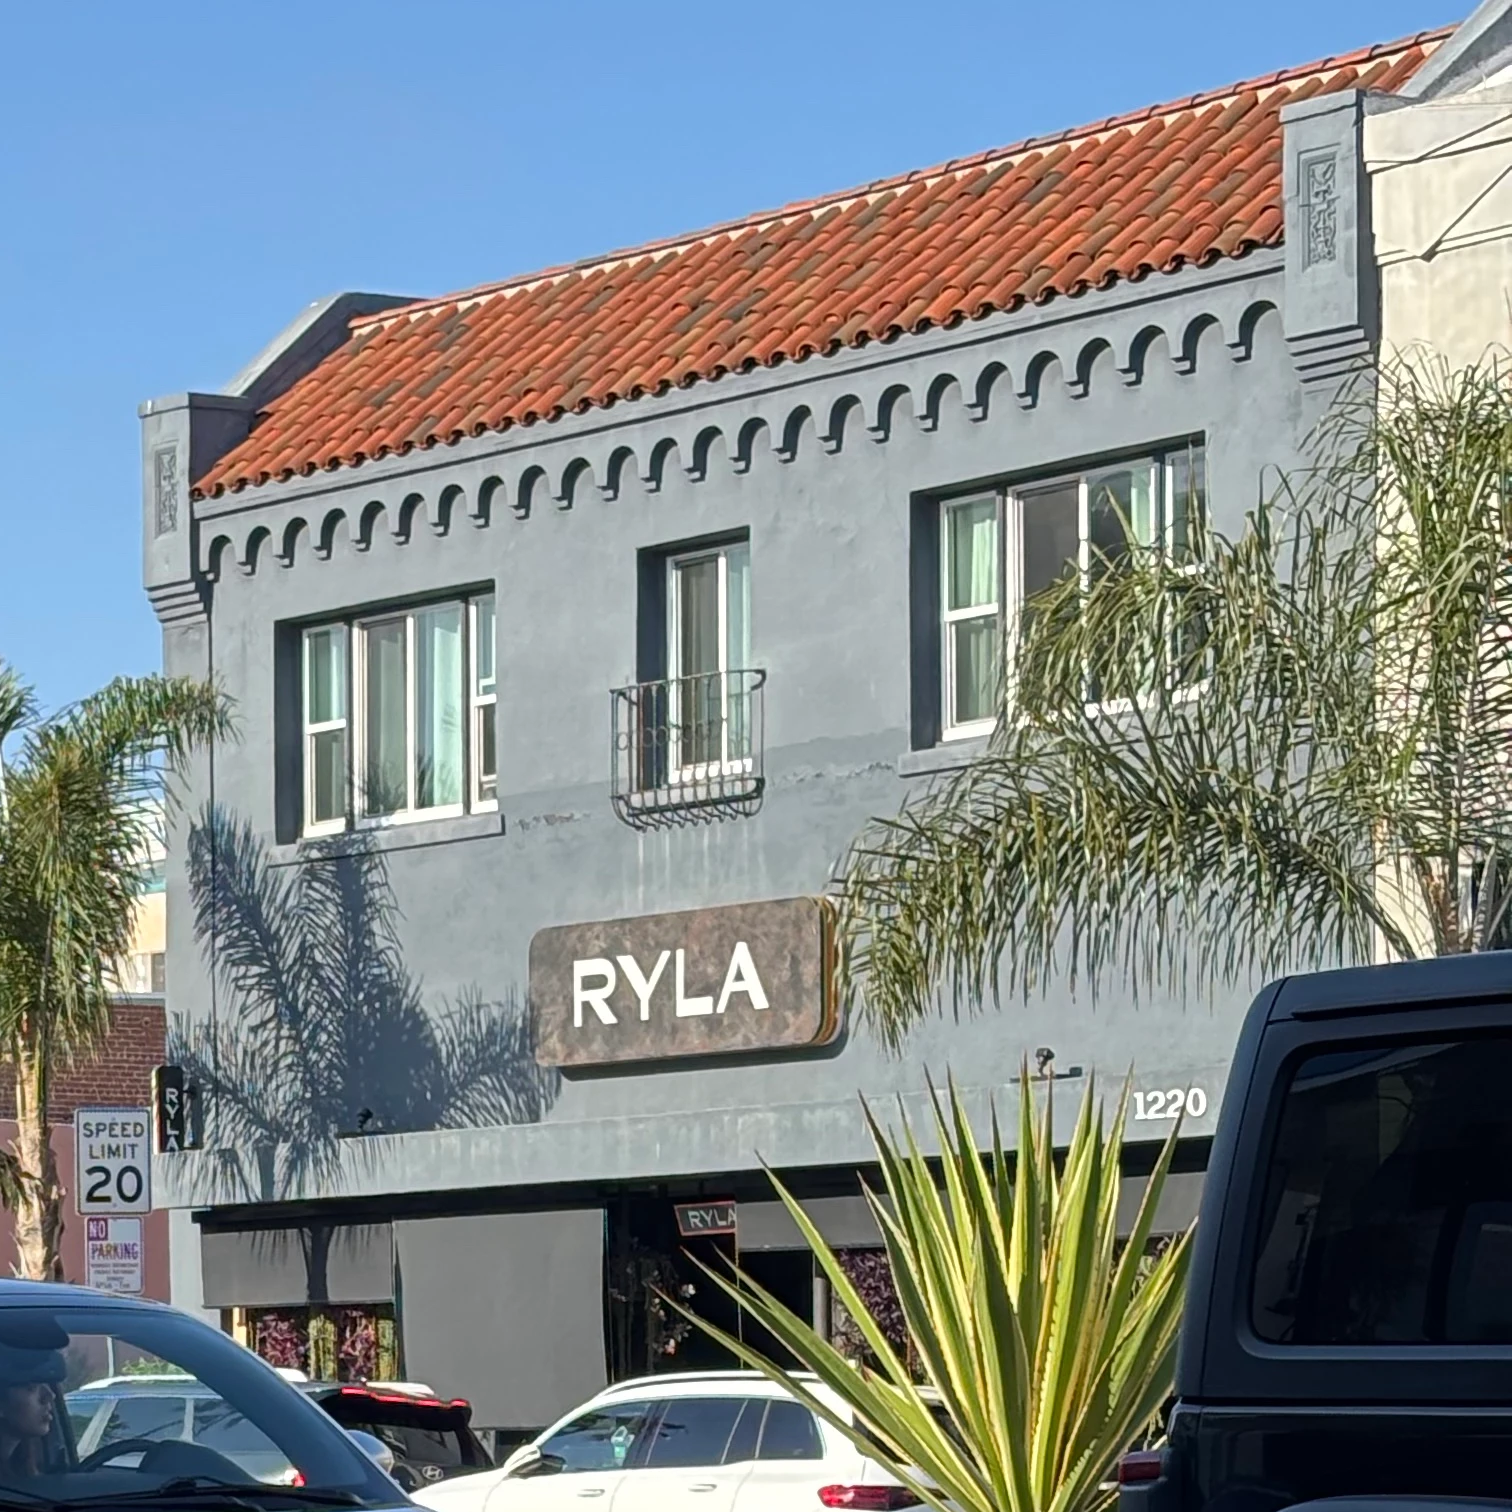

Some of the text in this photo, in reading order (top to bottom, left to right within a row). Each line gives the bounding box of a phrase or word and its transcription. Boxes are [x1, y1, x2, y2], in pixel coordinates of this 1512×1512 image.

[573, 941, 769, 1027] RYLA
[1133, 1087, 1207, 1120] 1220
[82, 1122, 145, 1138] SPEED
[164, 1087, 180, 1150] RYLA
[88, 1143, 137, 1160] LIMIT
[84, 1165, 143, 1204] 20
[89, 1220, 106, 1239] NO
[91, 1243, 139, 1260] PARKING
